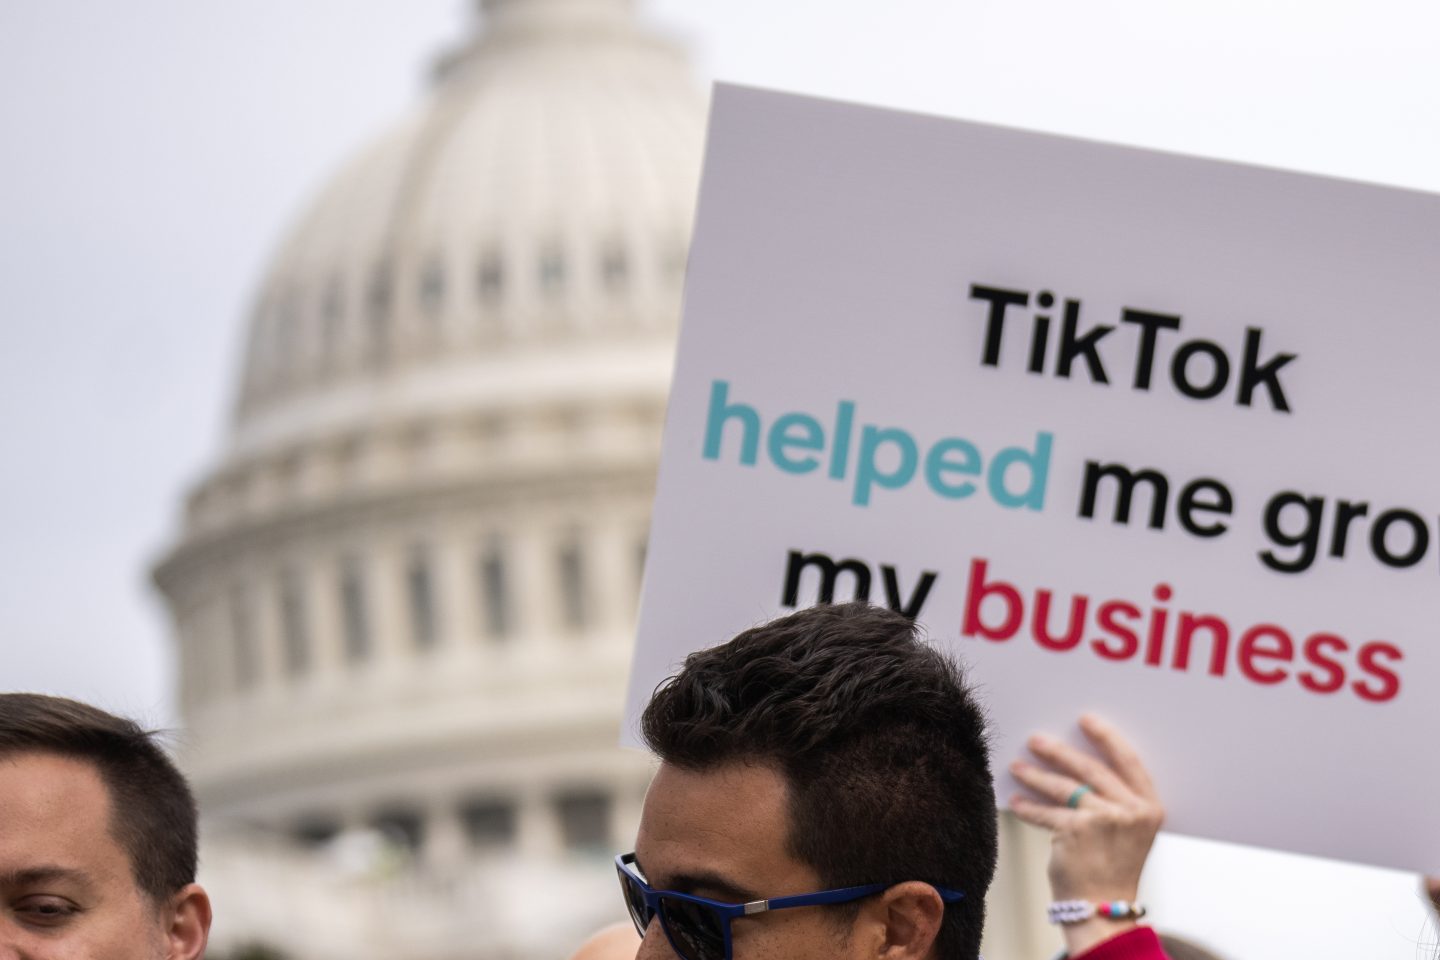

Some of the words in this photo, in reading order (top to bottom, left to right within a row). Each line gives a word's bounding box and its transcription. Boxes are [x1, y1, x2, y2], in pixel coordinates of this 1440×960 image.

[968, 283, 1298, 415] TikTok
[703, 381, 1054, 511] helped
[1077, 460, 1234, 540] me
[781, 549, 939, 621] my
[961, 557, 1404, 704] business
